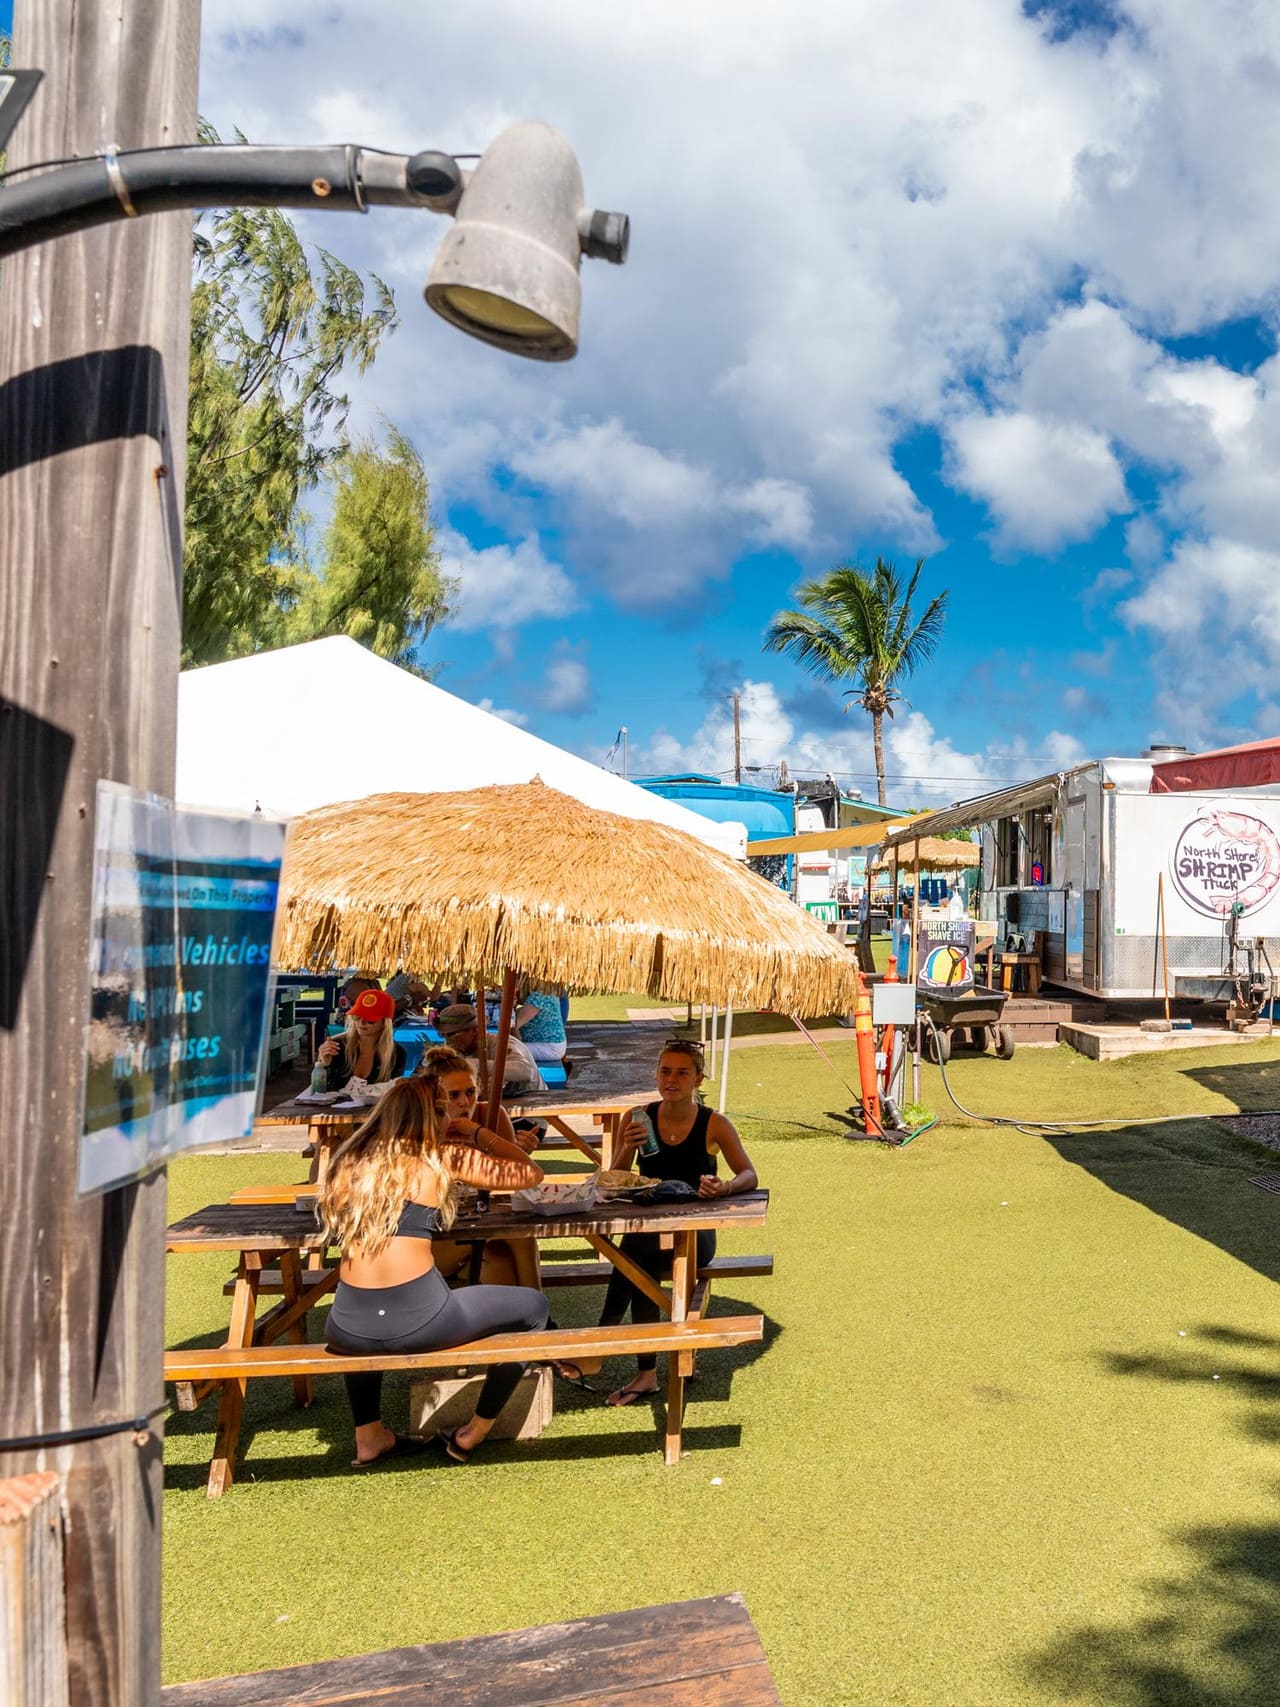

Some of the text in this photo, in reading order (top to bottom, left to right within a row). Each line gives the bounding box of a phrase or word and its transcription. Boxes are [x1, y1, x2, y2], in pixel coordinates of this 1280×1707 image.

[1178, 858, 1253, 881] SHRIMP
[192, 887, 207, 901] On
[208, 888, 229, 903] This
[231, 889, 275, 906] Property
[921, 921, 947, 931] NORTH
[927, 930, 966, 941] SHAVE ICE
[181, 934, 269, 966] Vehicles
